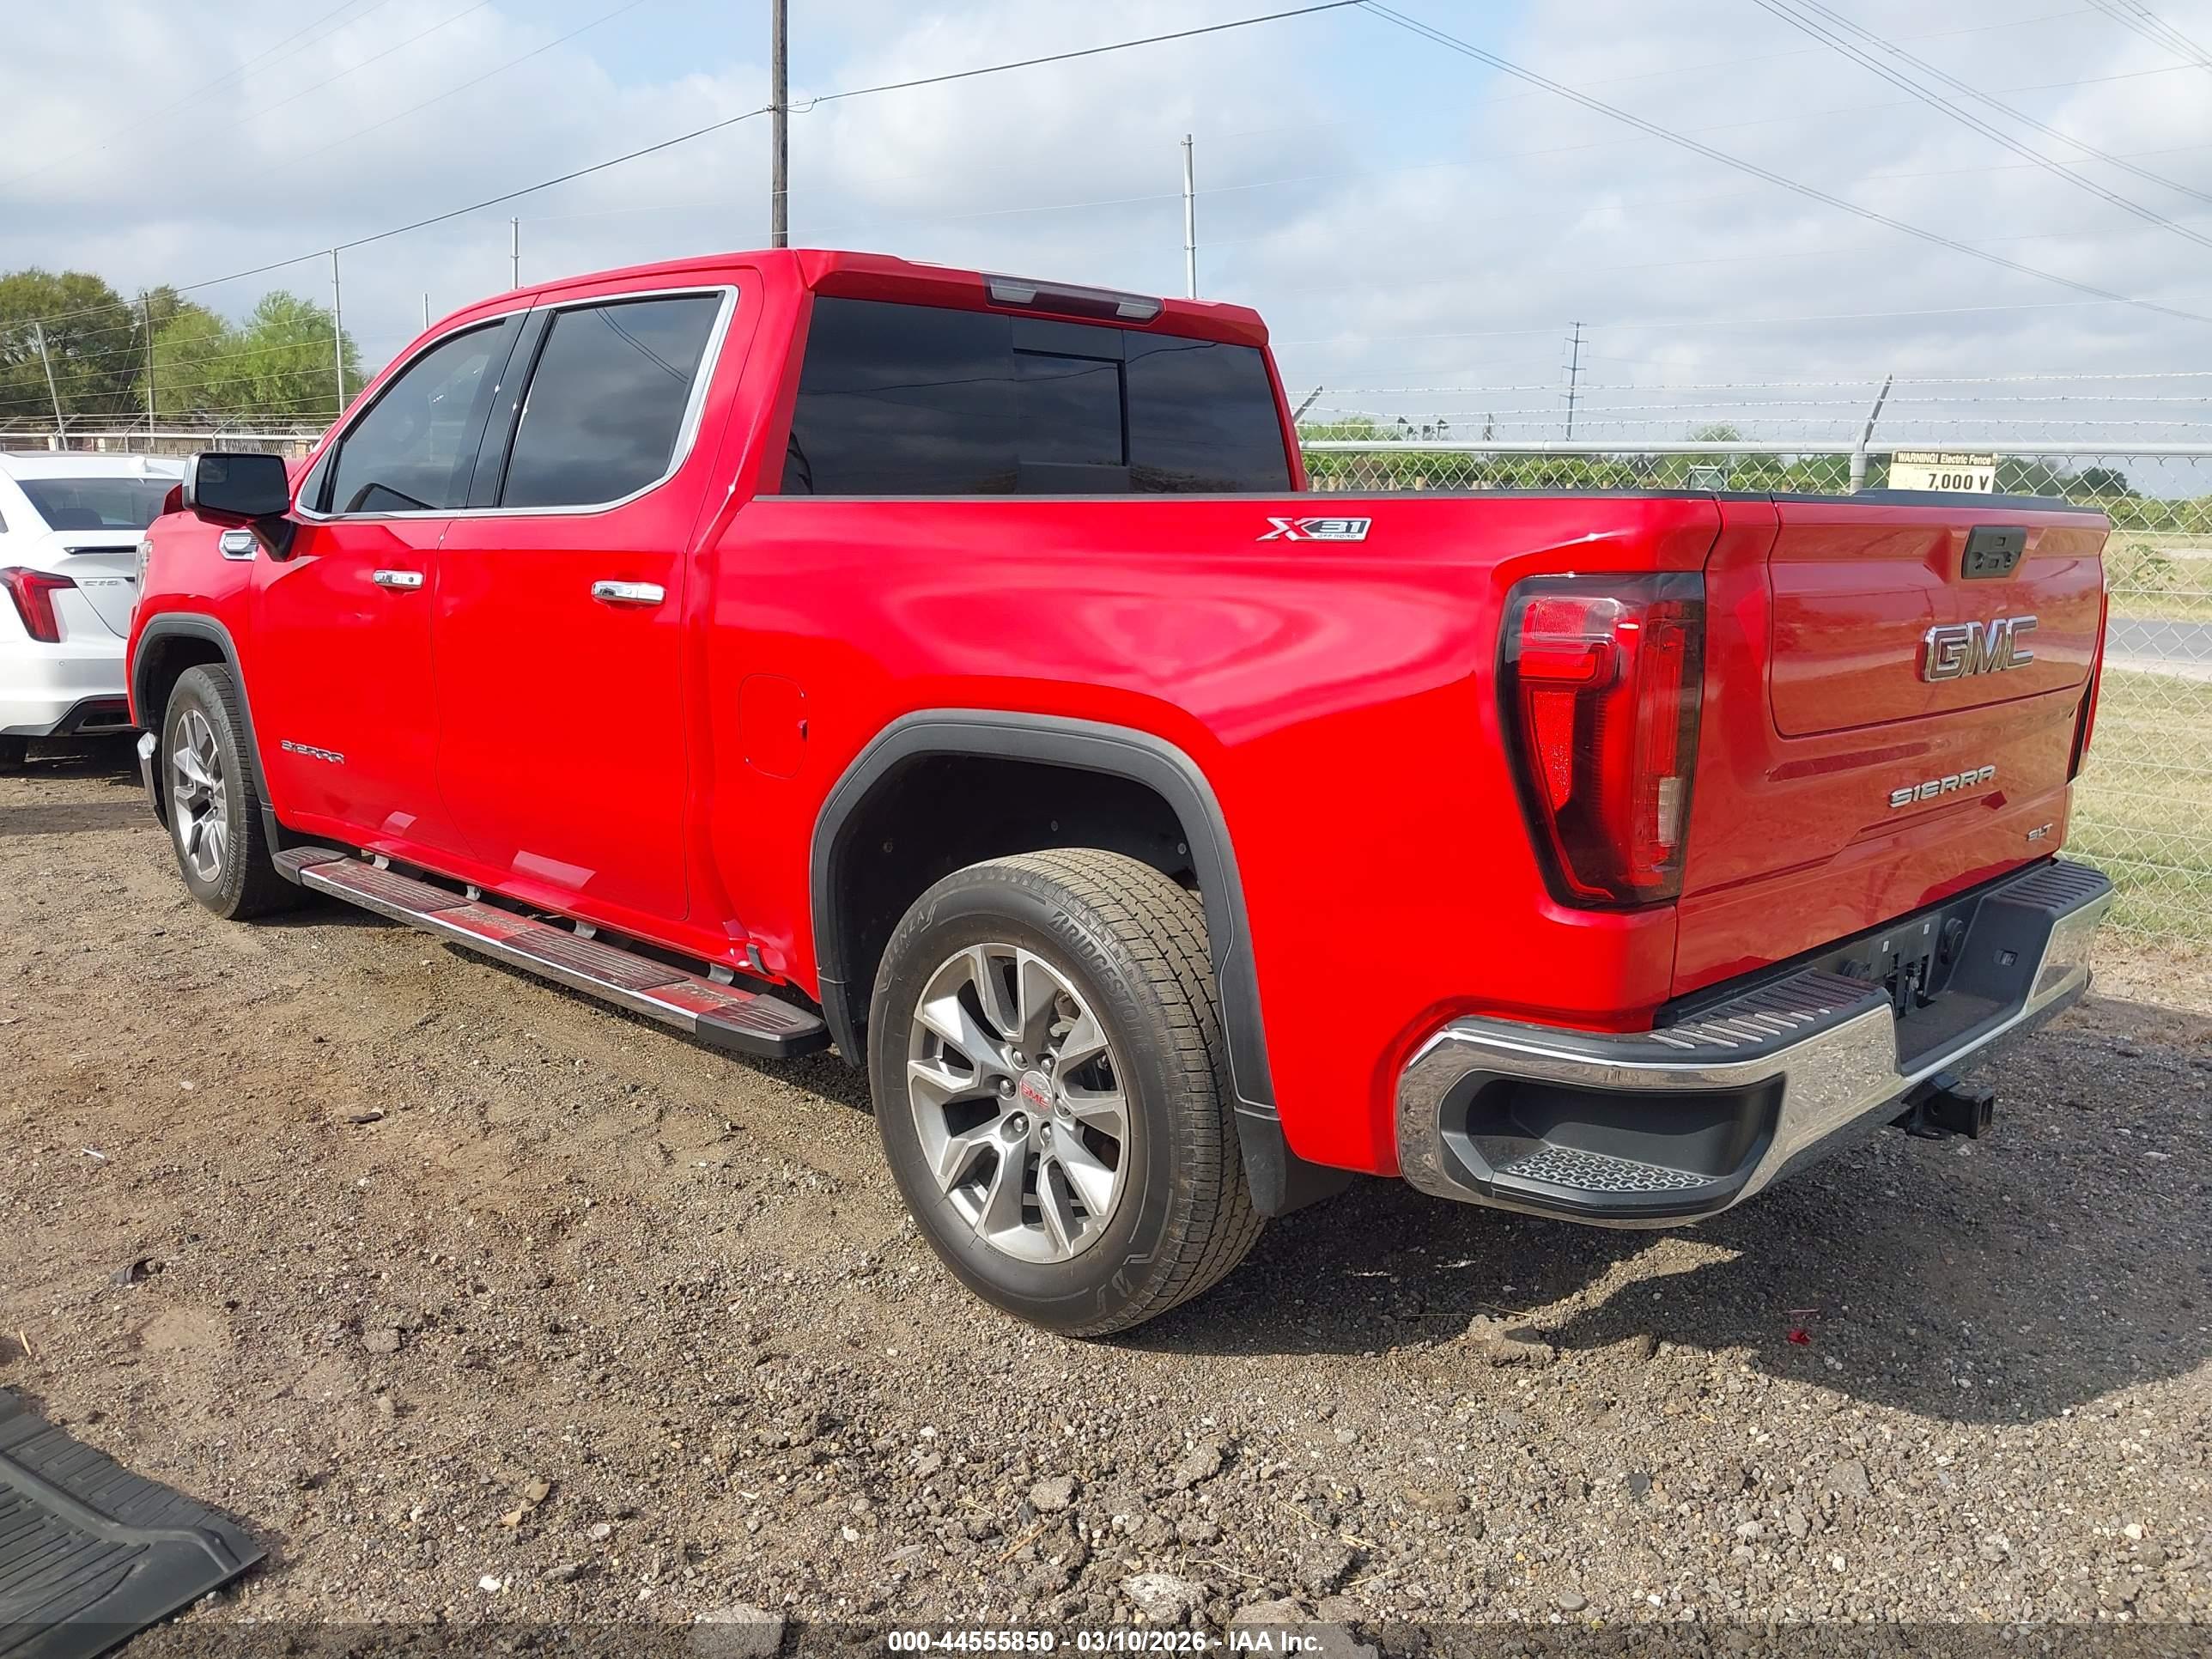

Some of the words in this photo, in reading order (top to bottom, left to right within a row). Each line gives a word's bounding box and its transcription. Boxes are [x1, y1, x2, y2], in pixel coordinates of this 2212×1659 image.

[1897, 452, 1938, 464] WARNING!
[1940, 453, 1968, 465] Electric
[1968, 454, 1991, 465] Fence
[1928, 473, 1973, 491] 7,000
[1978, 475, 1990, 491] V
[1923, 615, 2039, 683] GMC
[1889, 764, 1996, 809] SIERRA
